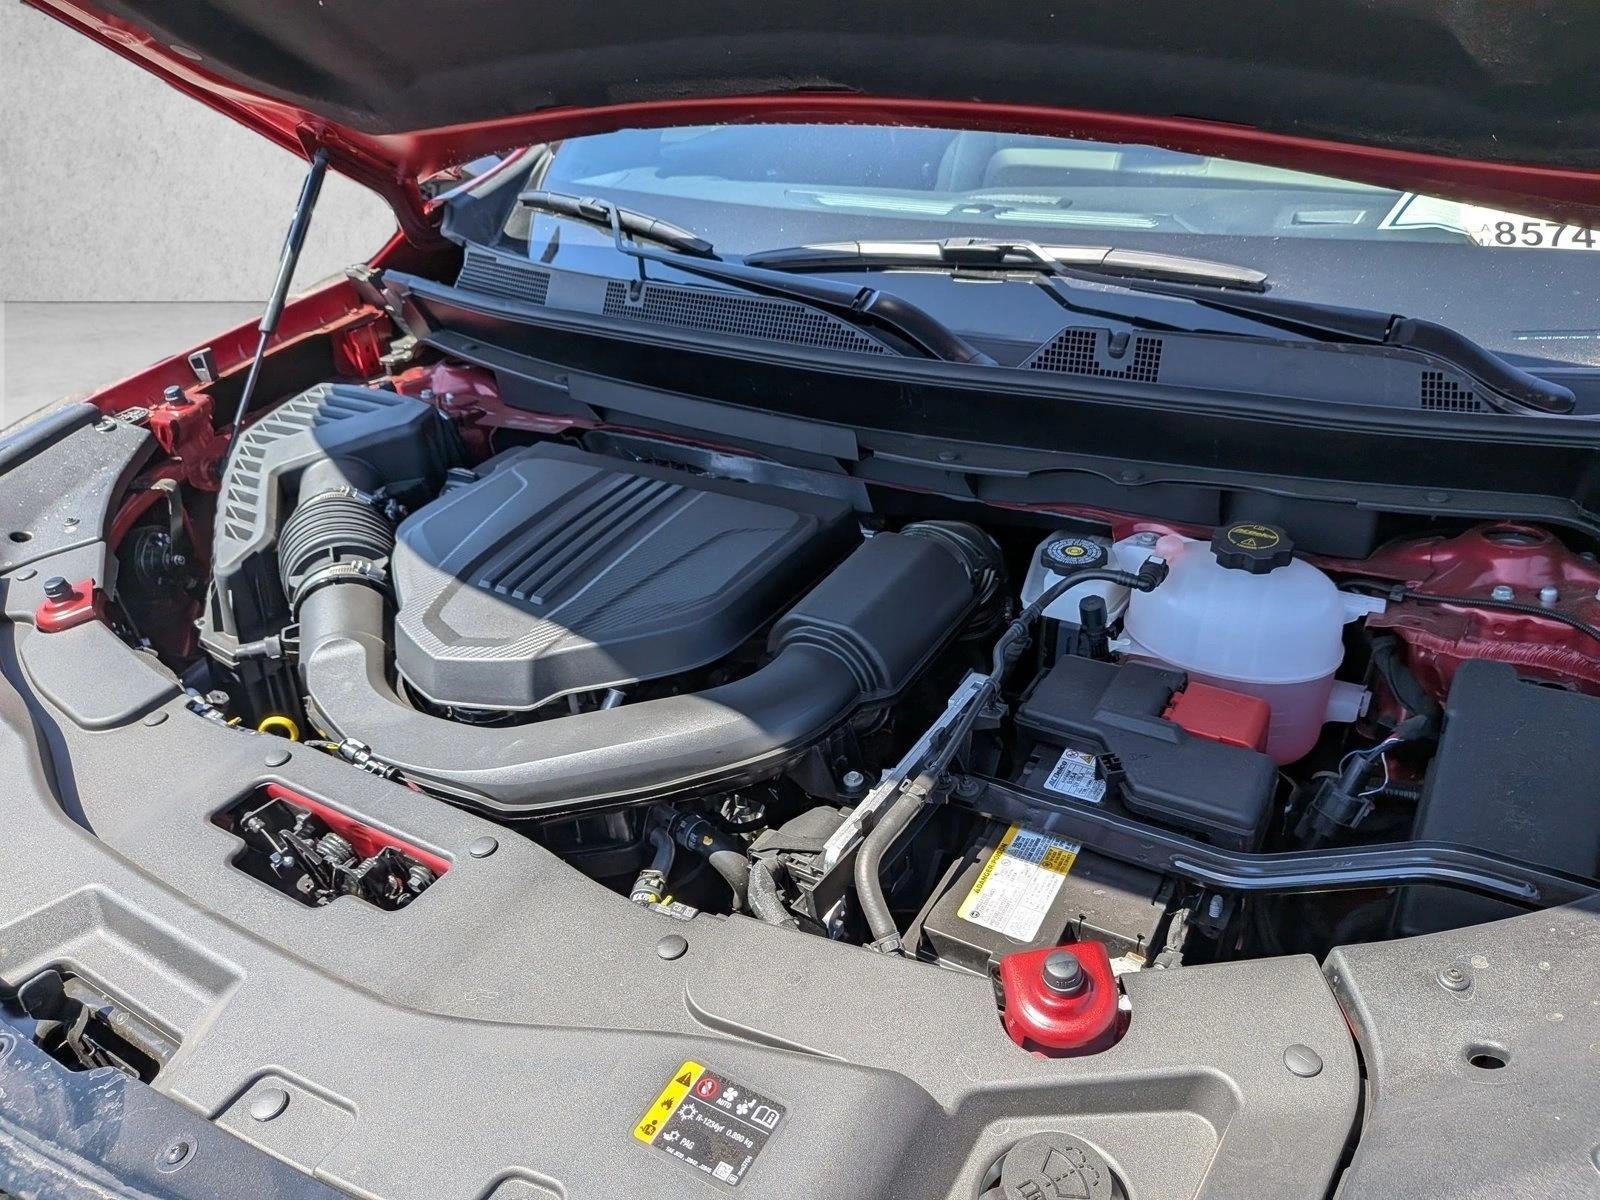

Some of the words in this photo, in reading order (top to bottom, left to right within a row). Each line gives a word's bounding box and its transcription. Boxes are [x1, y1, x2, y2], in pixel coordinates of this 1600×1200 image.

[1495, 221, 1597, 248] 8574
[715, 1097, 732, 1109] AUTO
[695, 1113, 725, 1132] R-1234yf
[743, 1137, 754, 1149] kg
[679, 1137, 695, 1150] PAG
